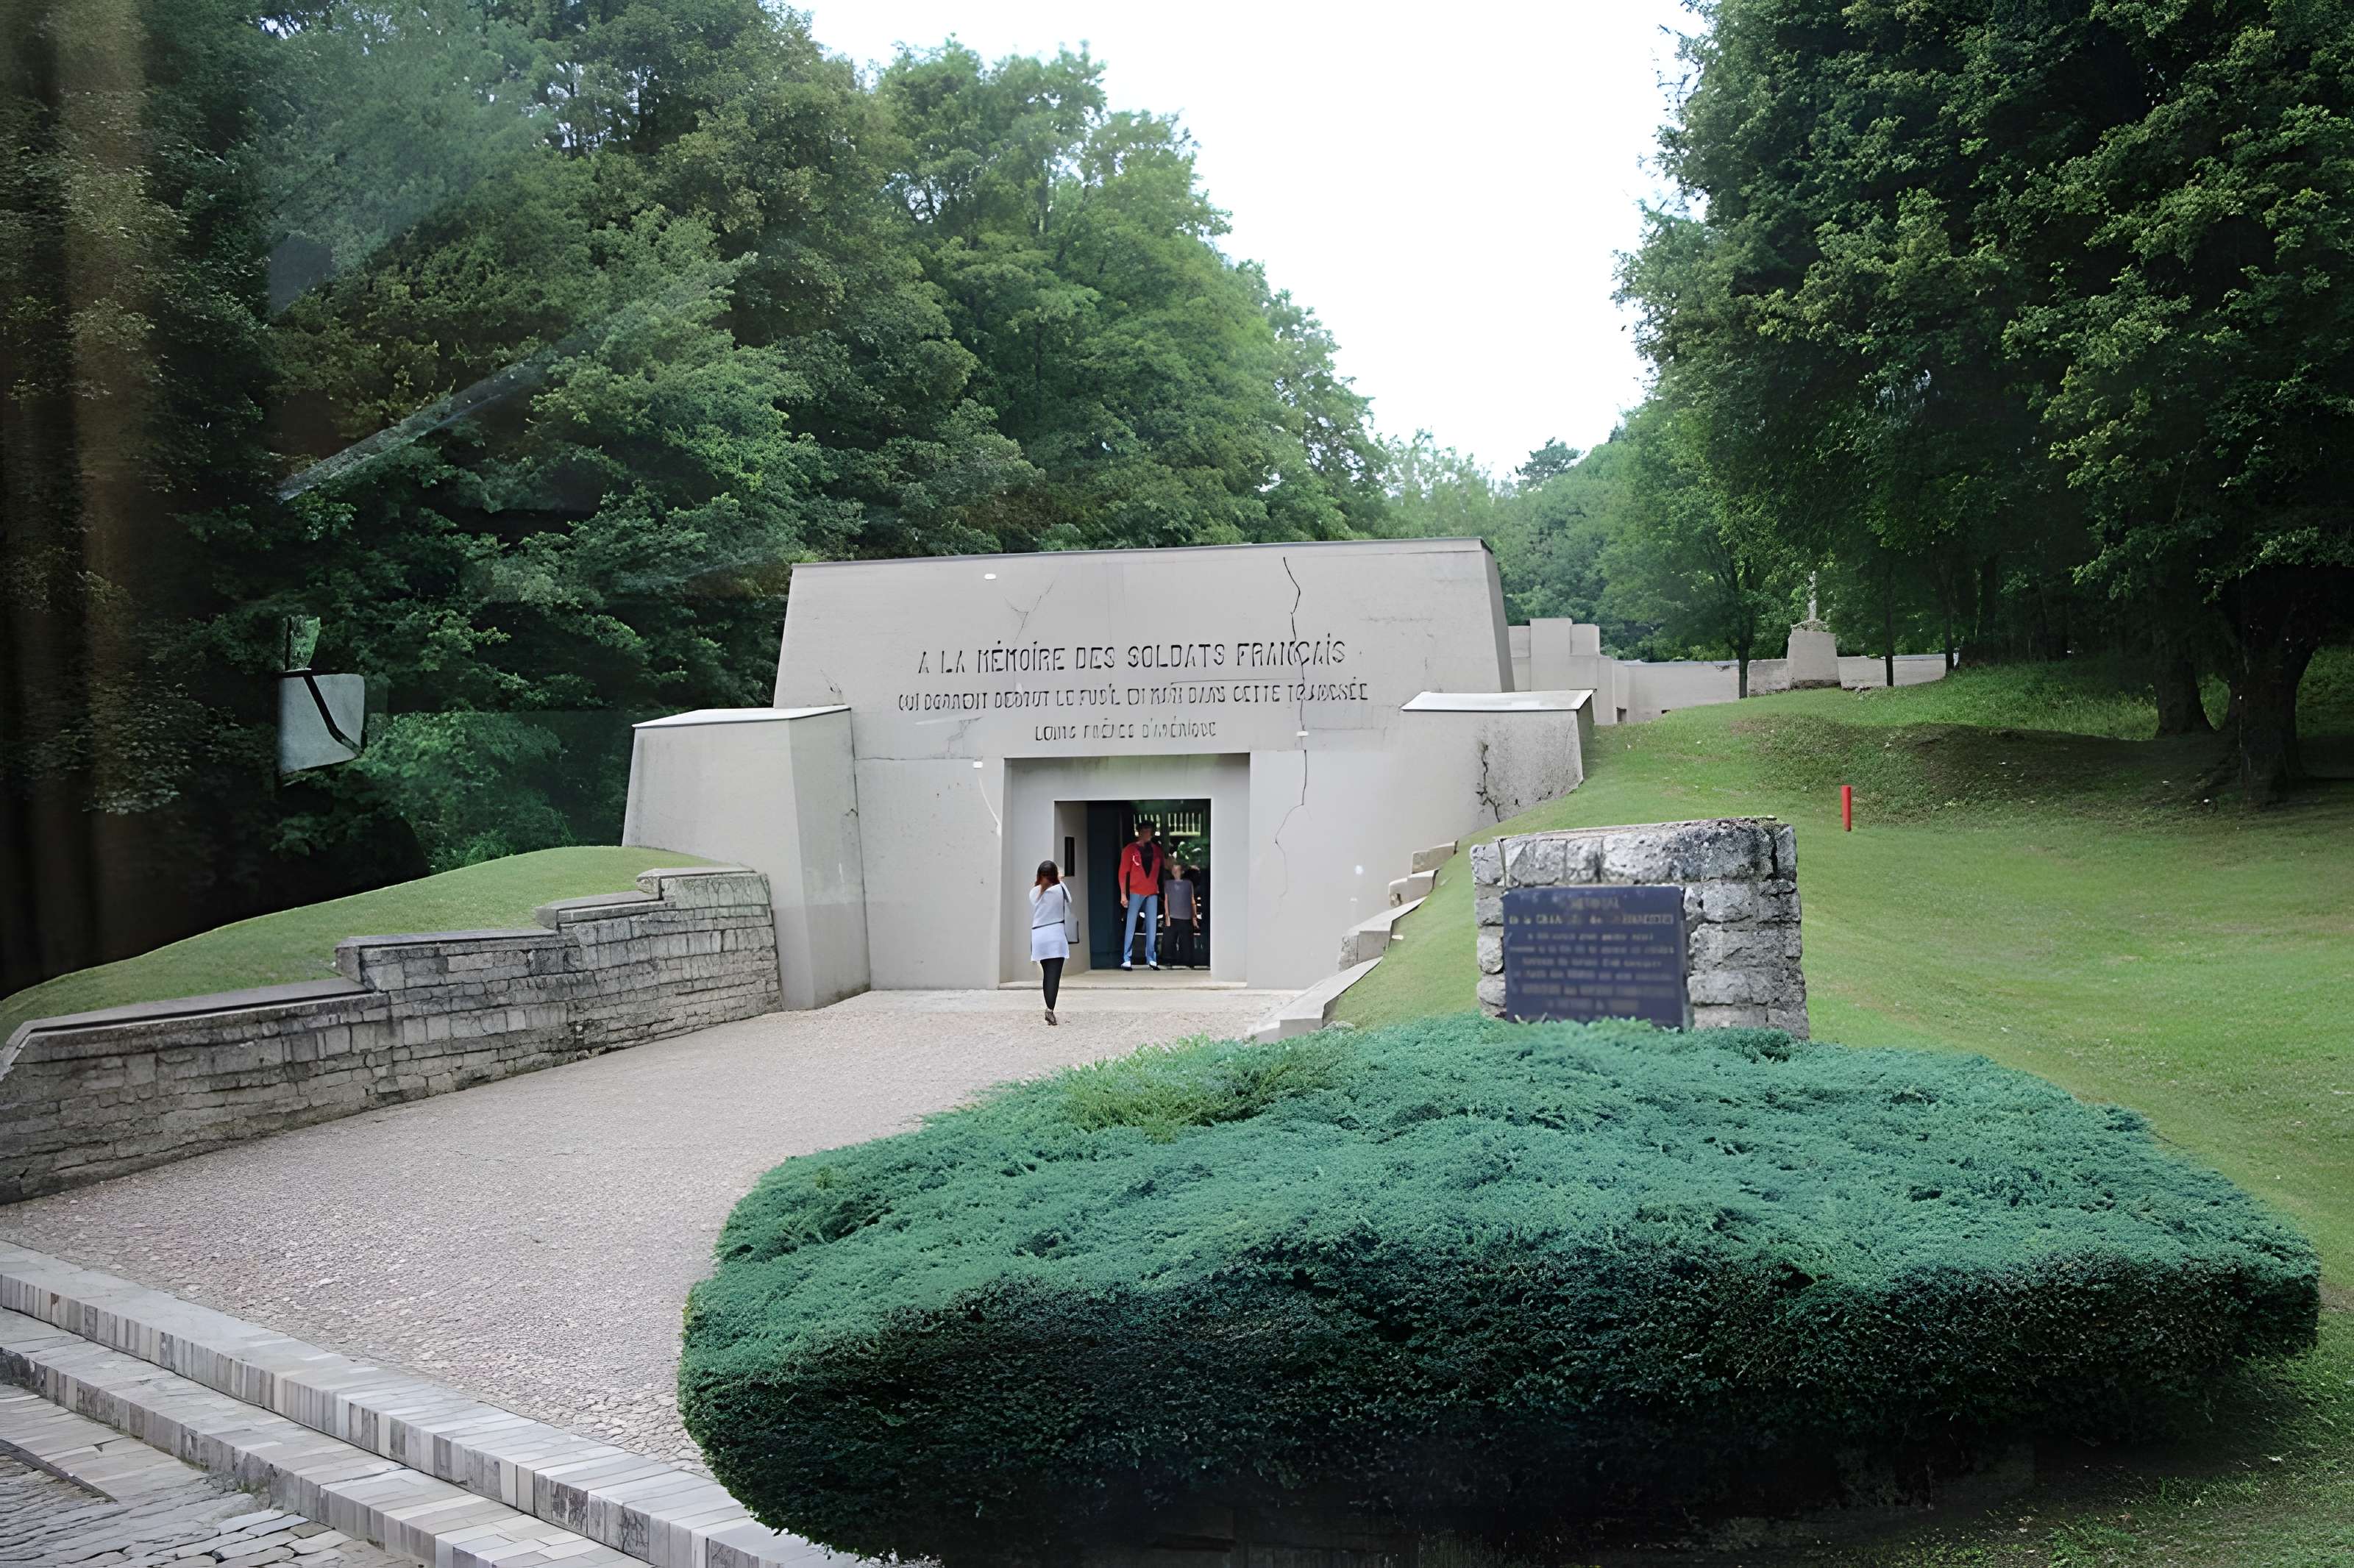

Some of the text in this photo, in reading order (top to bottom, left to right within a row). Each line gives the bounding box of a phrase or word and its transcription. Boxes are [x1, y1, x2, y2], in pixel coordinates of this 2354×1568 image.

[917, 650, 930, 674] A
[941, 649, 966, 674] LA
[1075, 646, 1115, 671] DES
[1127, 643, 1226, 669] SOLDATS
